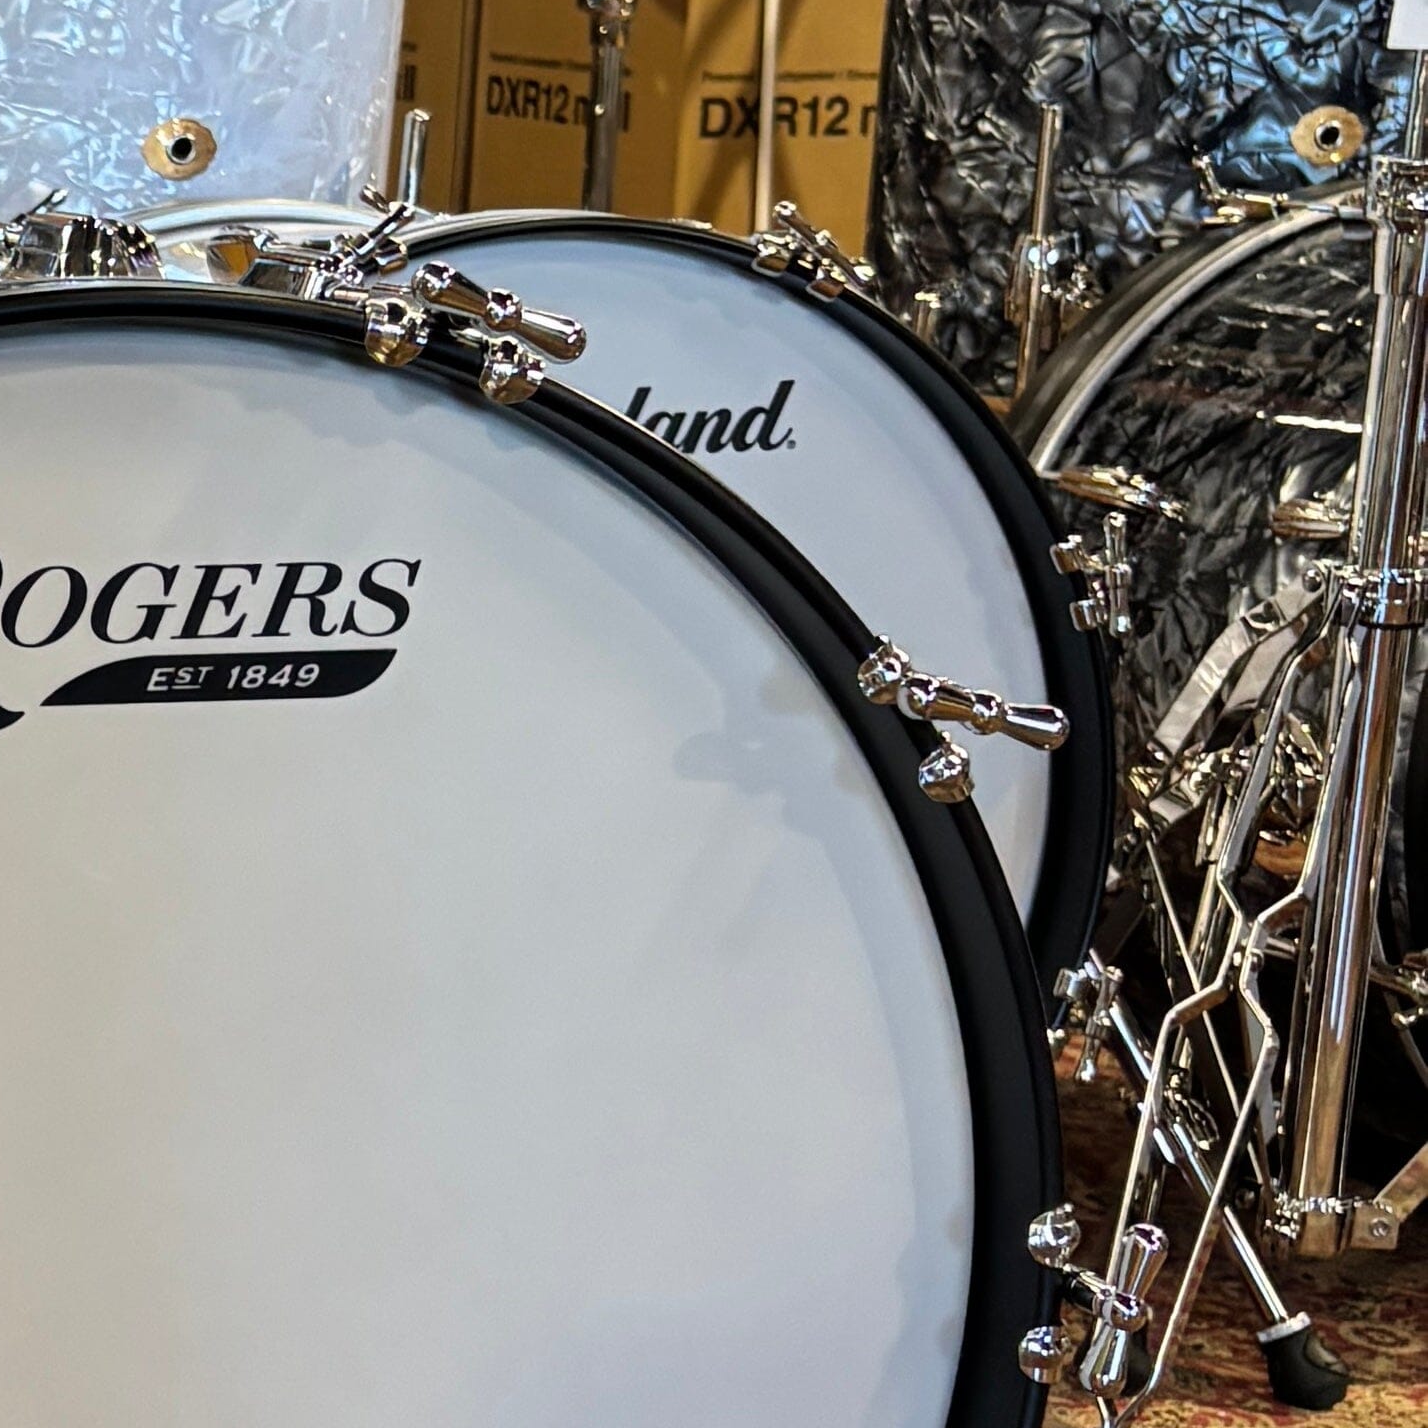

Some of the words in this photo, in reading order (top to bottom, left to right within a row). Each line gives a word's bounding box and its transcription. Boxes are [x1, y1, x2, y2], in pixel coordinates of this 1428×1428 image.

[486, 75, 569, 125] DXR12
[700, 95, 850, 139] DXR12
[226, 662, 320, 690] 1849
